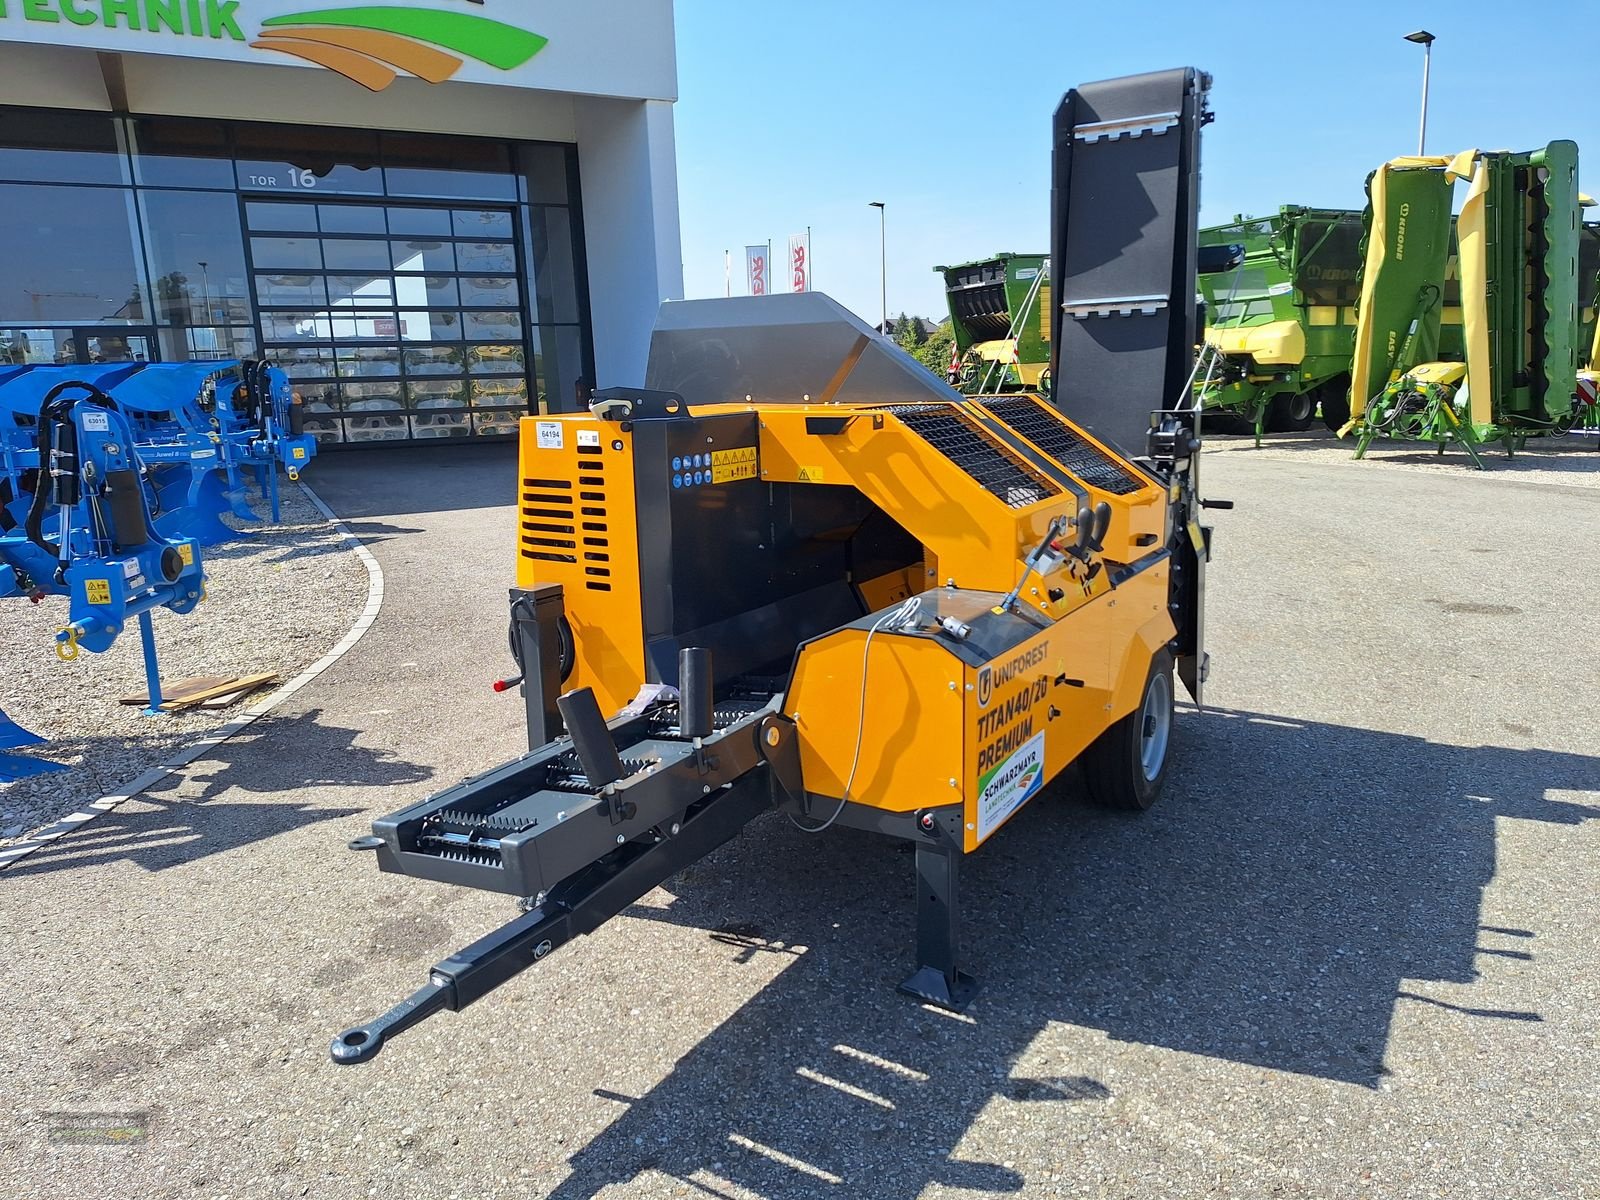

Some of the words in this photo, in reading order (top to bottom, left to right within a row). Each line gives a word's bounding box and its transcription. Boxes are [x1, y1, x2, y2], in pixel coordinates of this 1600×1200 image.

[0, 0, 246, 41] ECHNIK
[249, 175, 277, 186] TOR
[288, 168, 316, 188] 16
[1396, 217, 1407, 260] KRONE
[541, 430, 560, 438] 64194
[993, 640, 1049, 689] UNIFOREST
[977, 713, 1033, 777] PREMIUM
[984, 750, 1037, 802] SCHWARZMAYR
